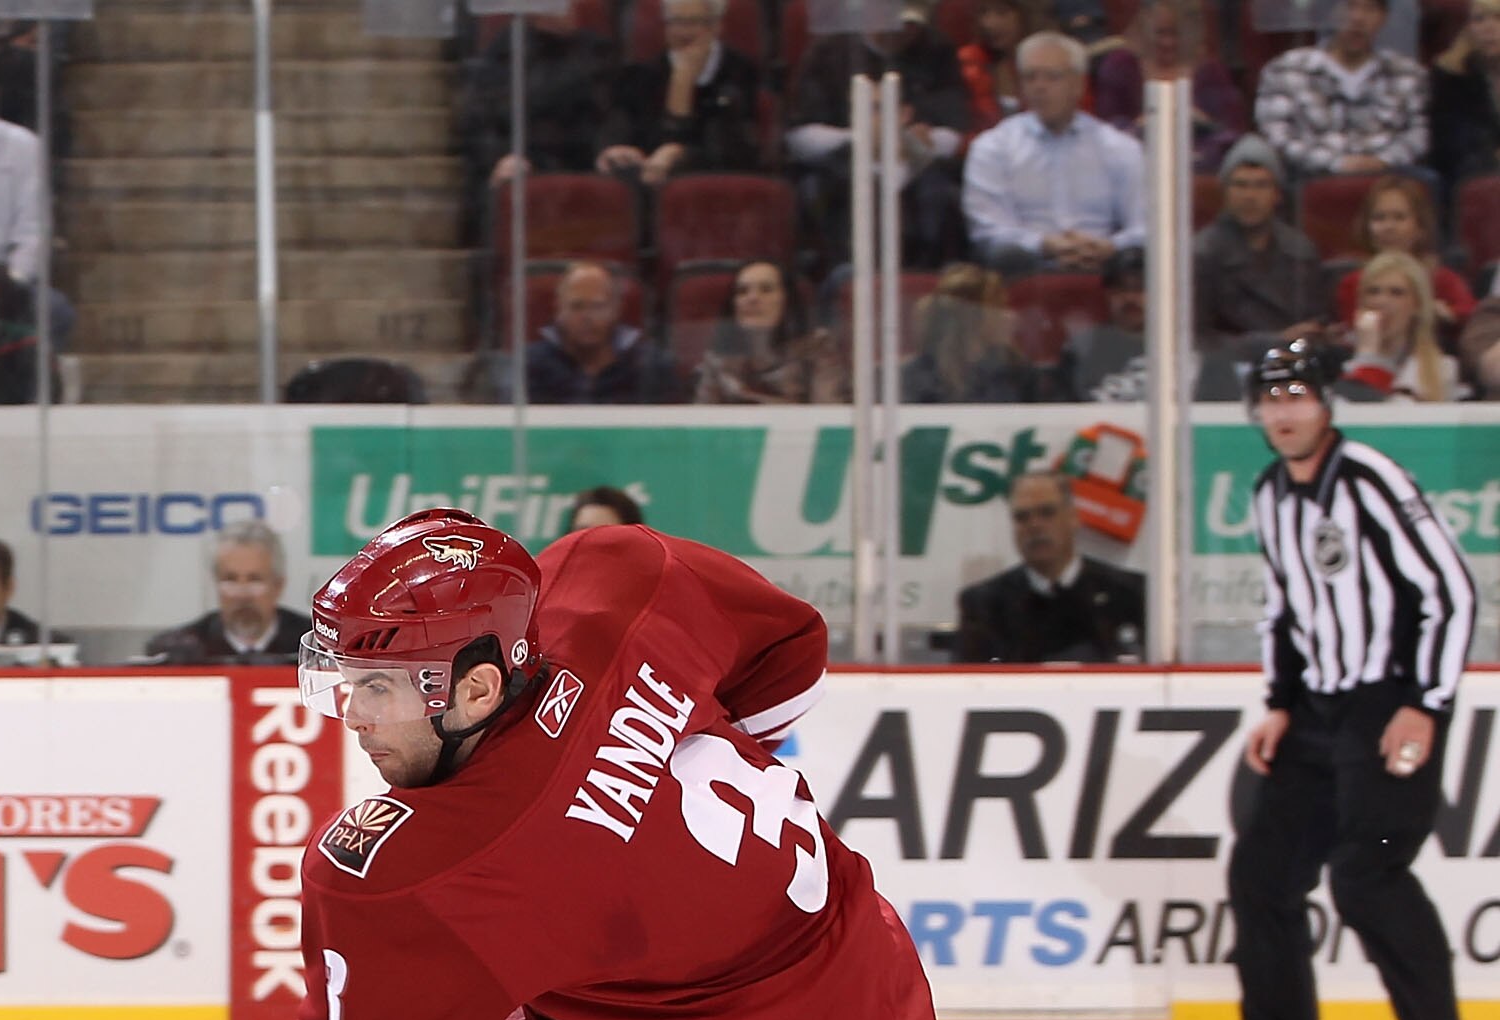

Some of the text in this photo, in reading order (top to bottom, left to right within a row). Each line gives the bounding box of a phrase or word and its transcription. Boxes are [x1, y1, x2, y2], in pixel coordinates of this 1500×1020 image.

[30, 491, 266, 535] GEICO
[315, 617, 340, 642] Reebok
[564, 661, 696, 843] YANDLE
[251, 686, 324, 1001] Reebok
[330, 827, 371, 855] PHX
